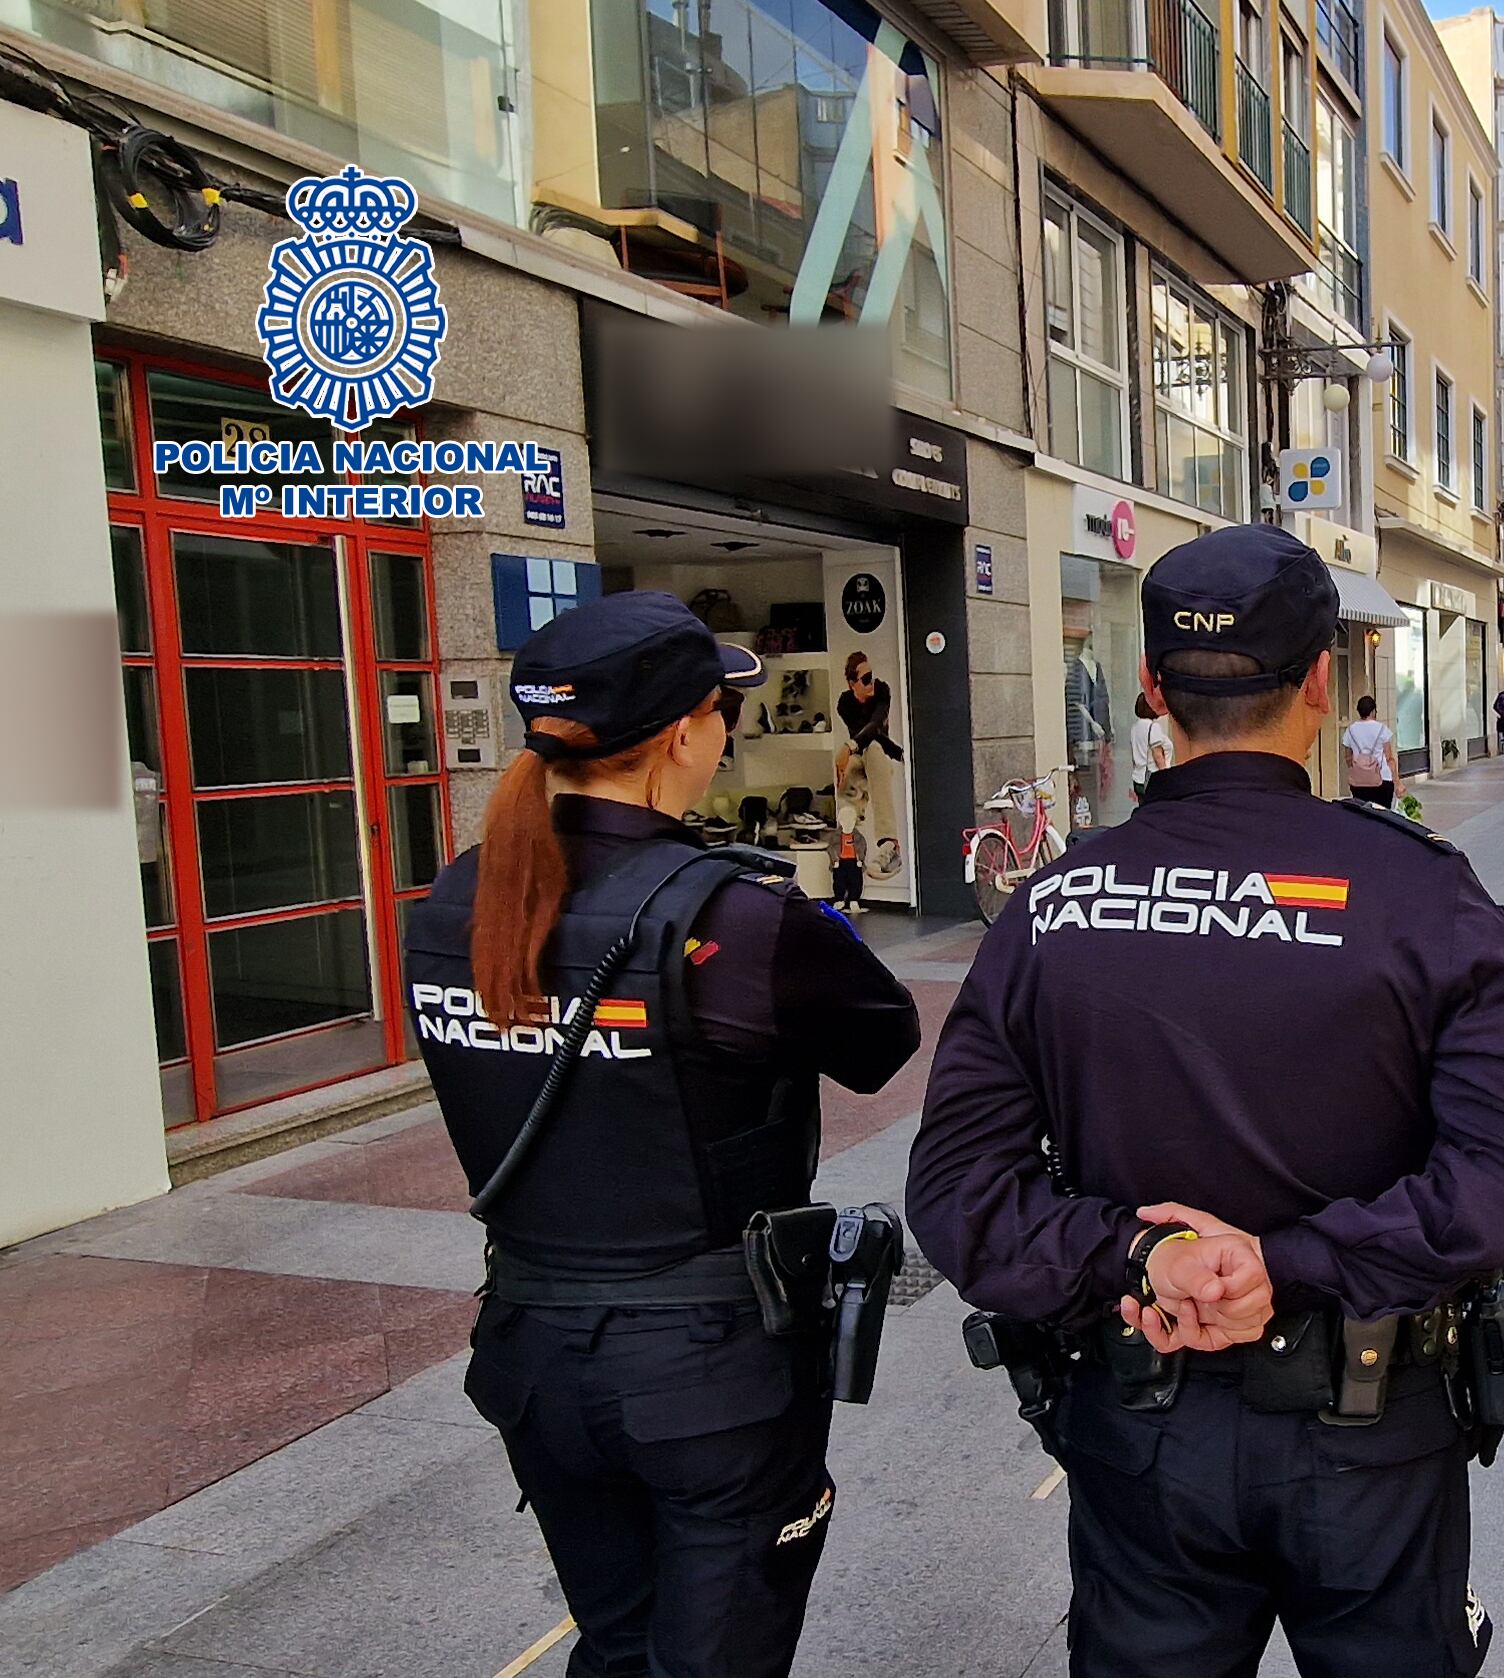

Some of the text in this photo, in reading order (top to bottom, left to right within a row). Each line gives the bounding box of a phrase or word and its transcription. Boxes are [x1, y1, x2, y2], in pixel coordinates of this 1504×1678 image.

[1173, 611, 1235, 634] CNP
[1029, 864, 1276, 913] POLICIA
[1031, 899, 1343, 946] NACIONAL
